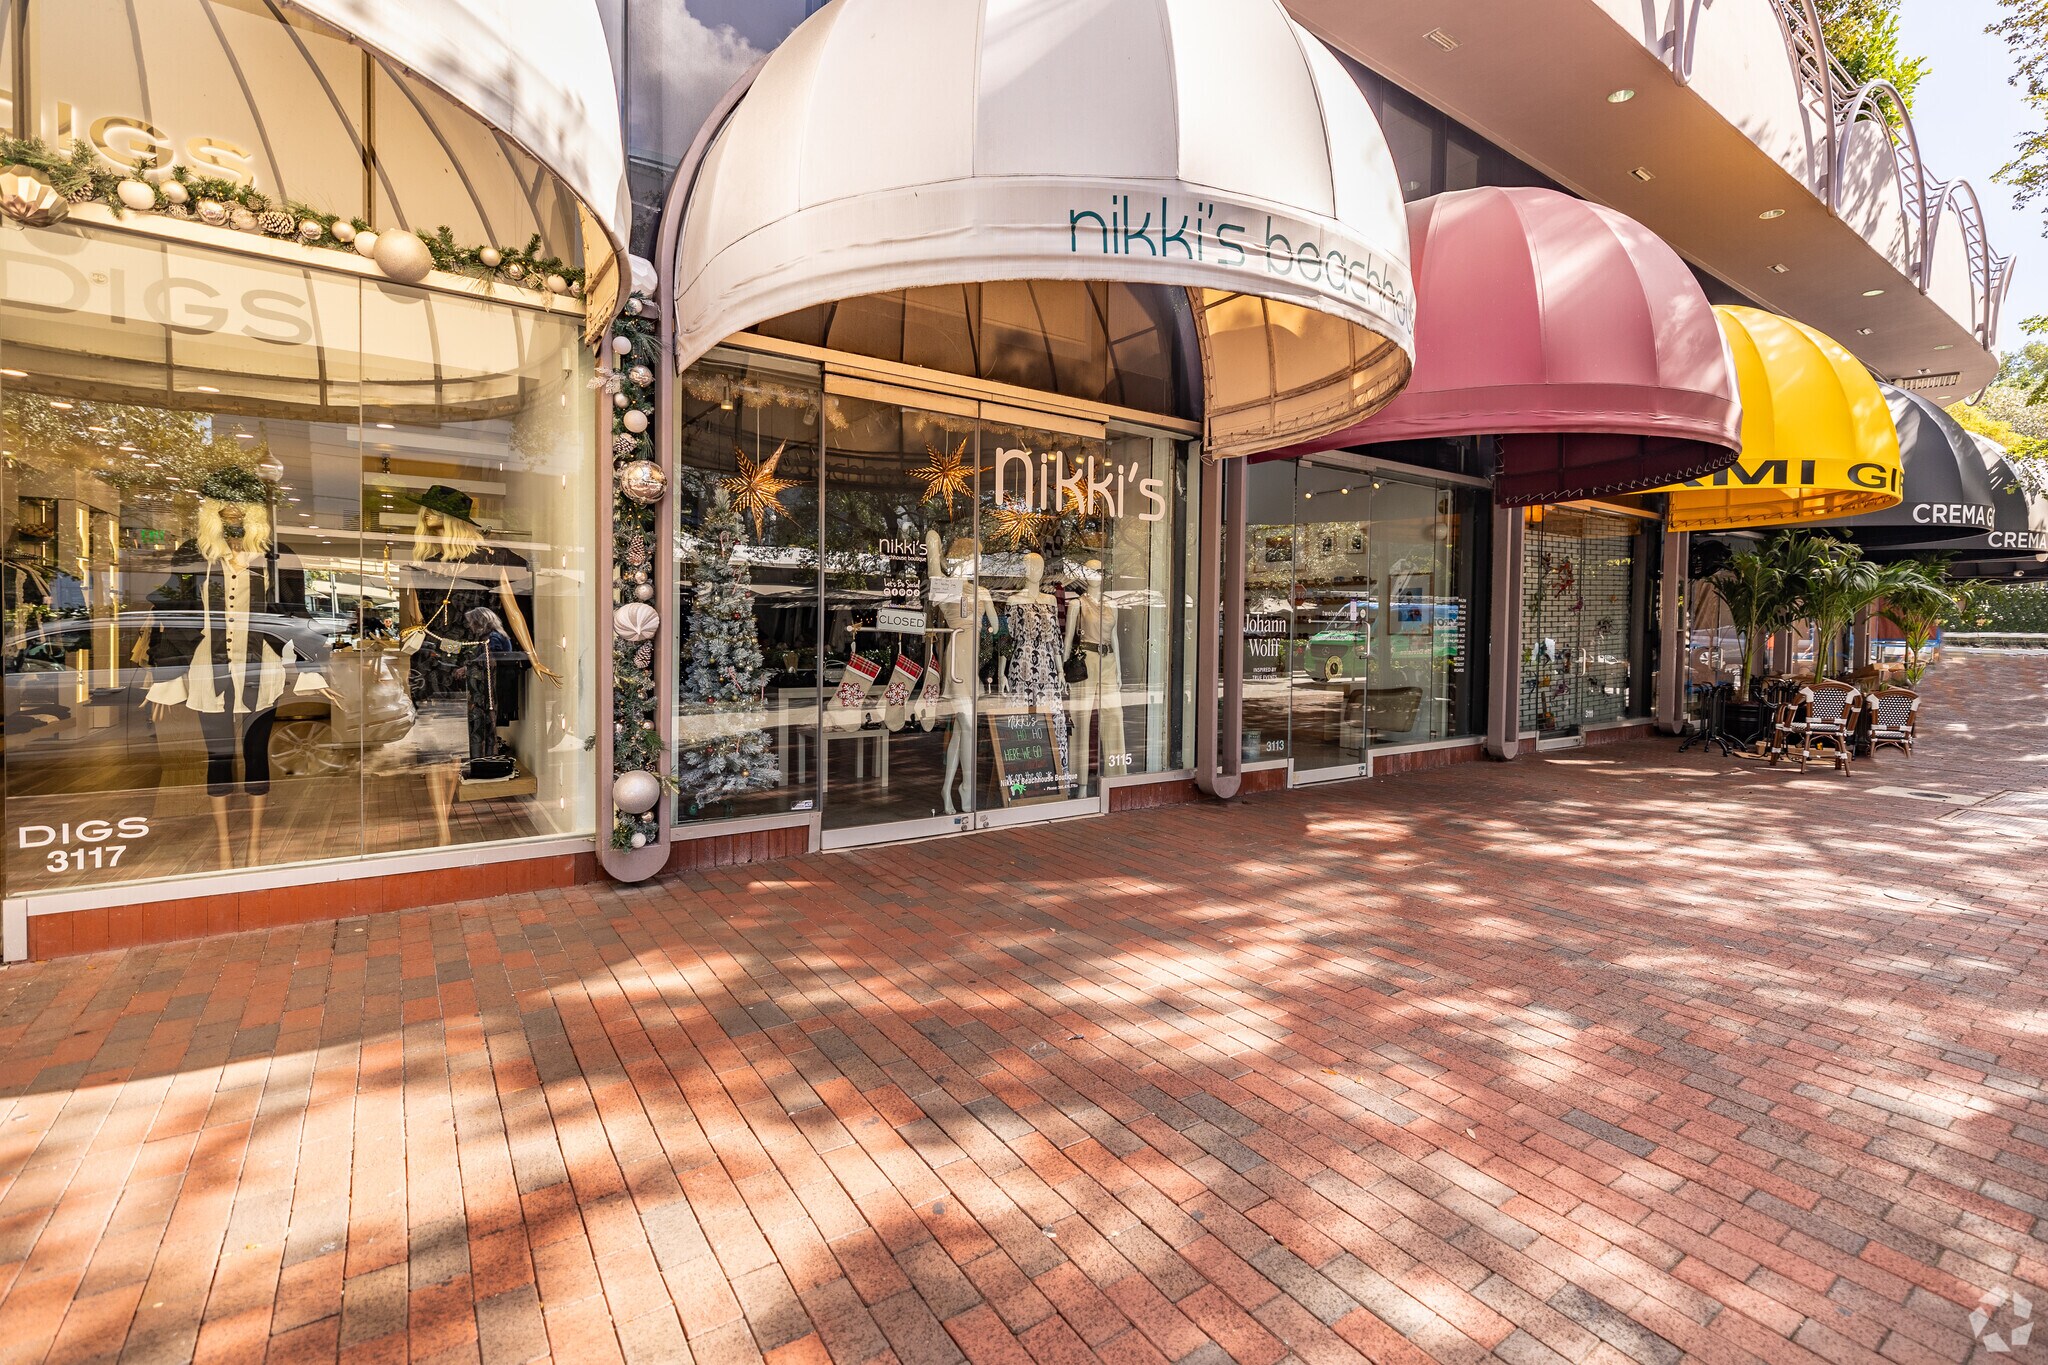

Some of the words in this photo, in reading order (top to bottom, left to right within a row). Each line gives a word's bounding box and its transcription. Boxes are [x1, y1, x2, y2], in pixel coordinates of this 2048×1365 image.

[1070, 195, 1246, 267] nikki's
[1680, 460, 1816, 487] MI
[1912, 503, 1985, 526] CREMA
[1988, 531, 2047, 549] CREMA
[879, 614, 925, 628] CLOSED
[1243, 614, 1287, 633] Johann
[1249, 638, 1281, 657] Wolff
[1032, 728, 1043, 739] HO
[1004, 747, 1021, 761] HERE
[1266, 740, 1285, 751] 3113
[1108, 753, 1132, 767] 3115
[18, 816, 150, 849] DIGS
[46, 845, 127, 873] 3117
